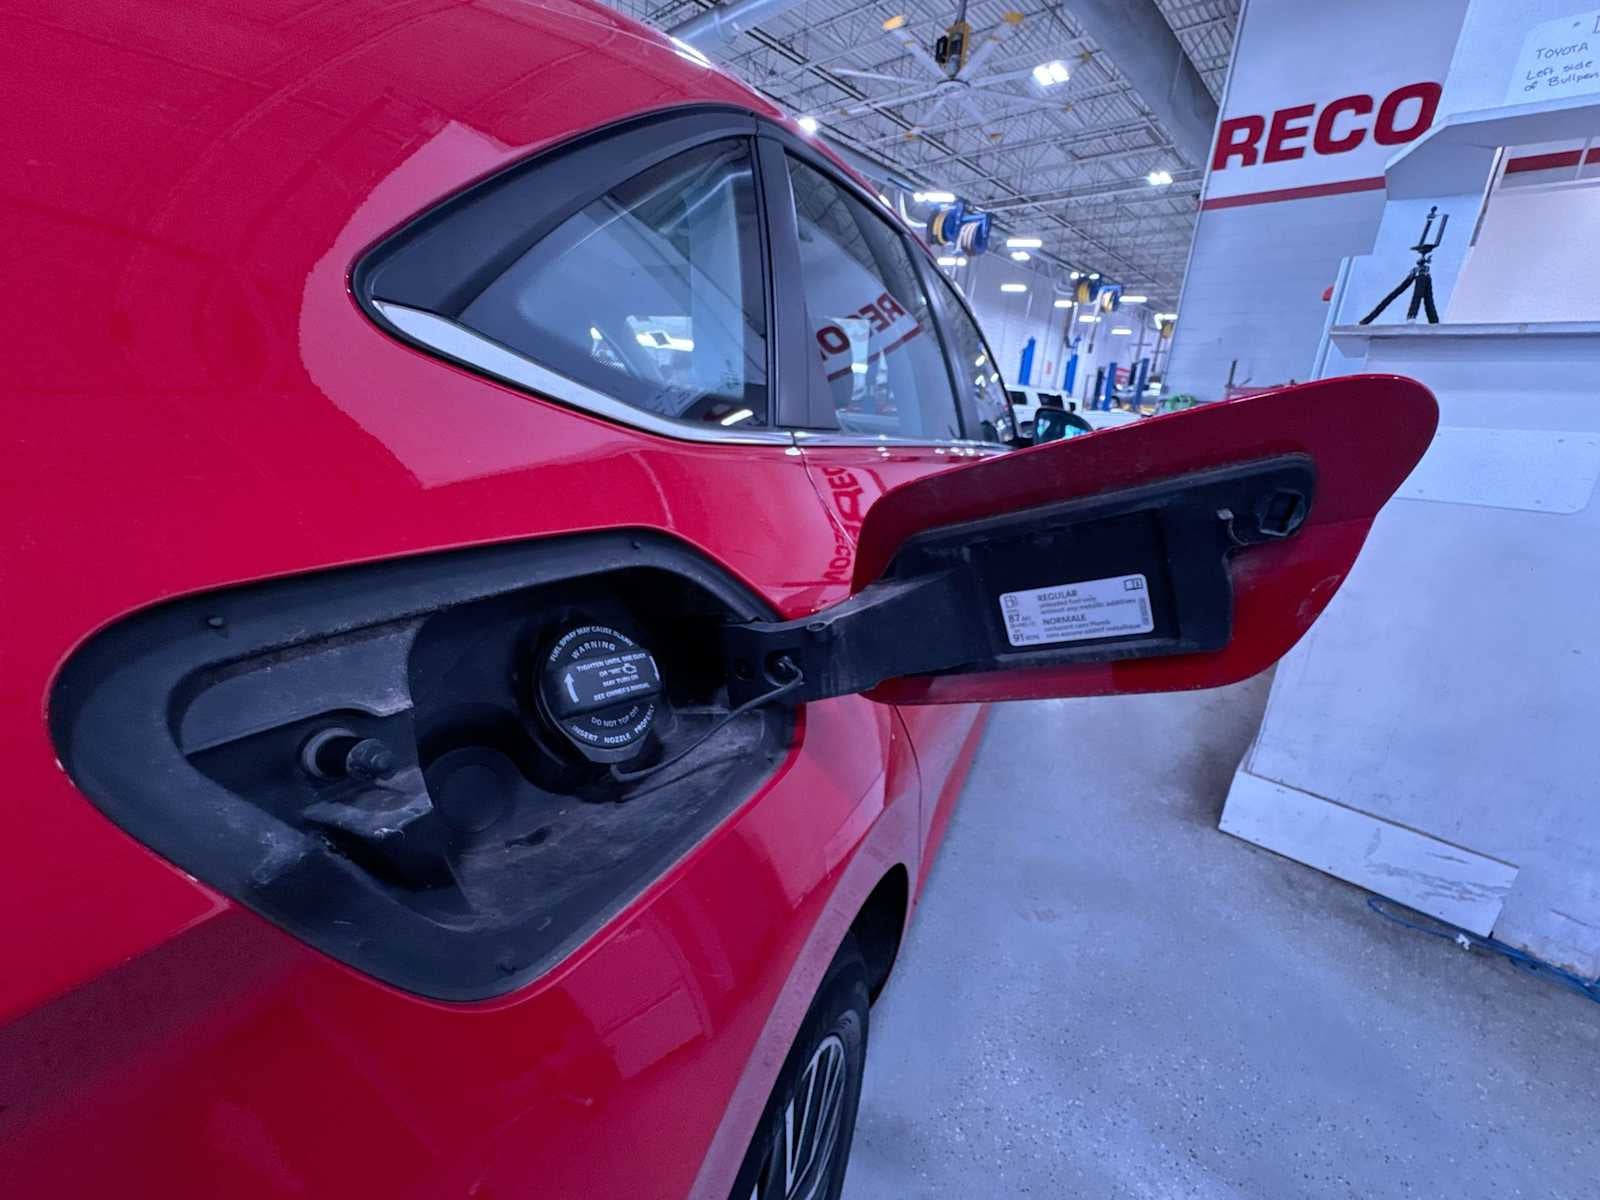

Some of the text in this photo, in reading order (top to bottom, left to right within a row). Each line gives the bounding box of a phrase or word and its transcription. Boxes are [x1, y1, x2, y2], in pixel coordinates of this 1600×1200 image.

[1536, 42, 1589, 59] TOYOTA
[1526, 61, 1593, 81] Left side
[1524, 81, 1539, 92] of
[1037, 589, 1077, 602] REGULAR
[1008, 614, 1020, 624] 87
[1042, 614, 1087, 626] NORMALE
[550, 646, 562, 662] FUEL
[559, 631, 577, 648] SPRAY
[576, 626, 591, 635] MAY
[591, 625, 612, 635] CAUSE
[1012, 633, 1024, 643] 91
[571, 640, 616, 660] WARNING
[576, 660, 605, 673] TIGHTEN
[604, 657, 622, 666] UNTIL
[603, 679, 615, 688] MAY
[616, 676, 631, 684] TURN
[593, 692, 606, 701] SEE
[591, 716, 602, 726] DO
[603, 719, 617, 727] NOT
[618, 714, 630, 725] TOP
[571, 724, 598, 743] INSERT
[604, 732, 632, 744] NOZZLE
